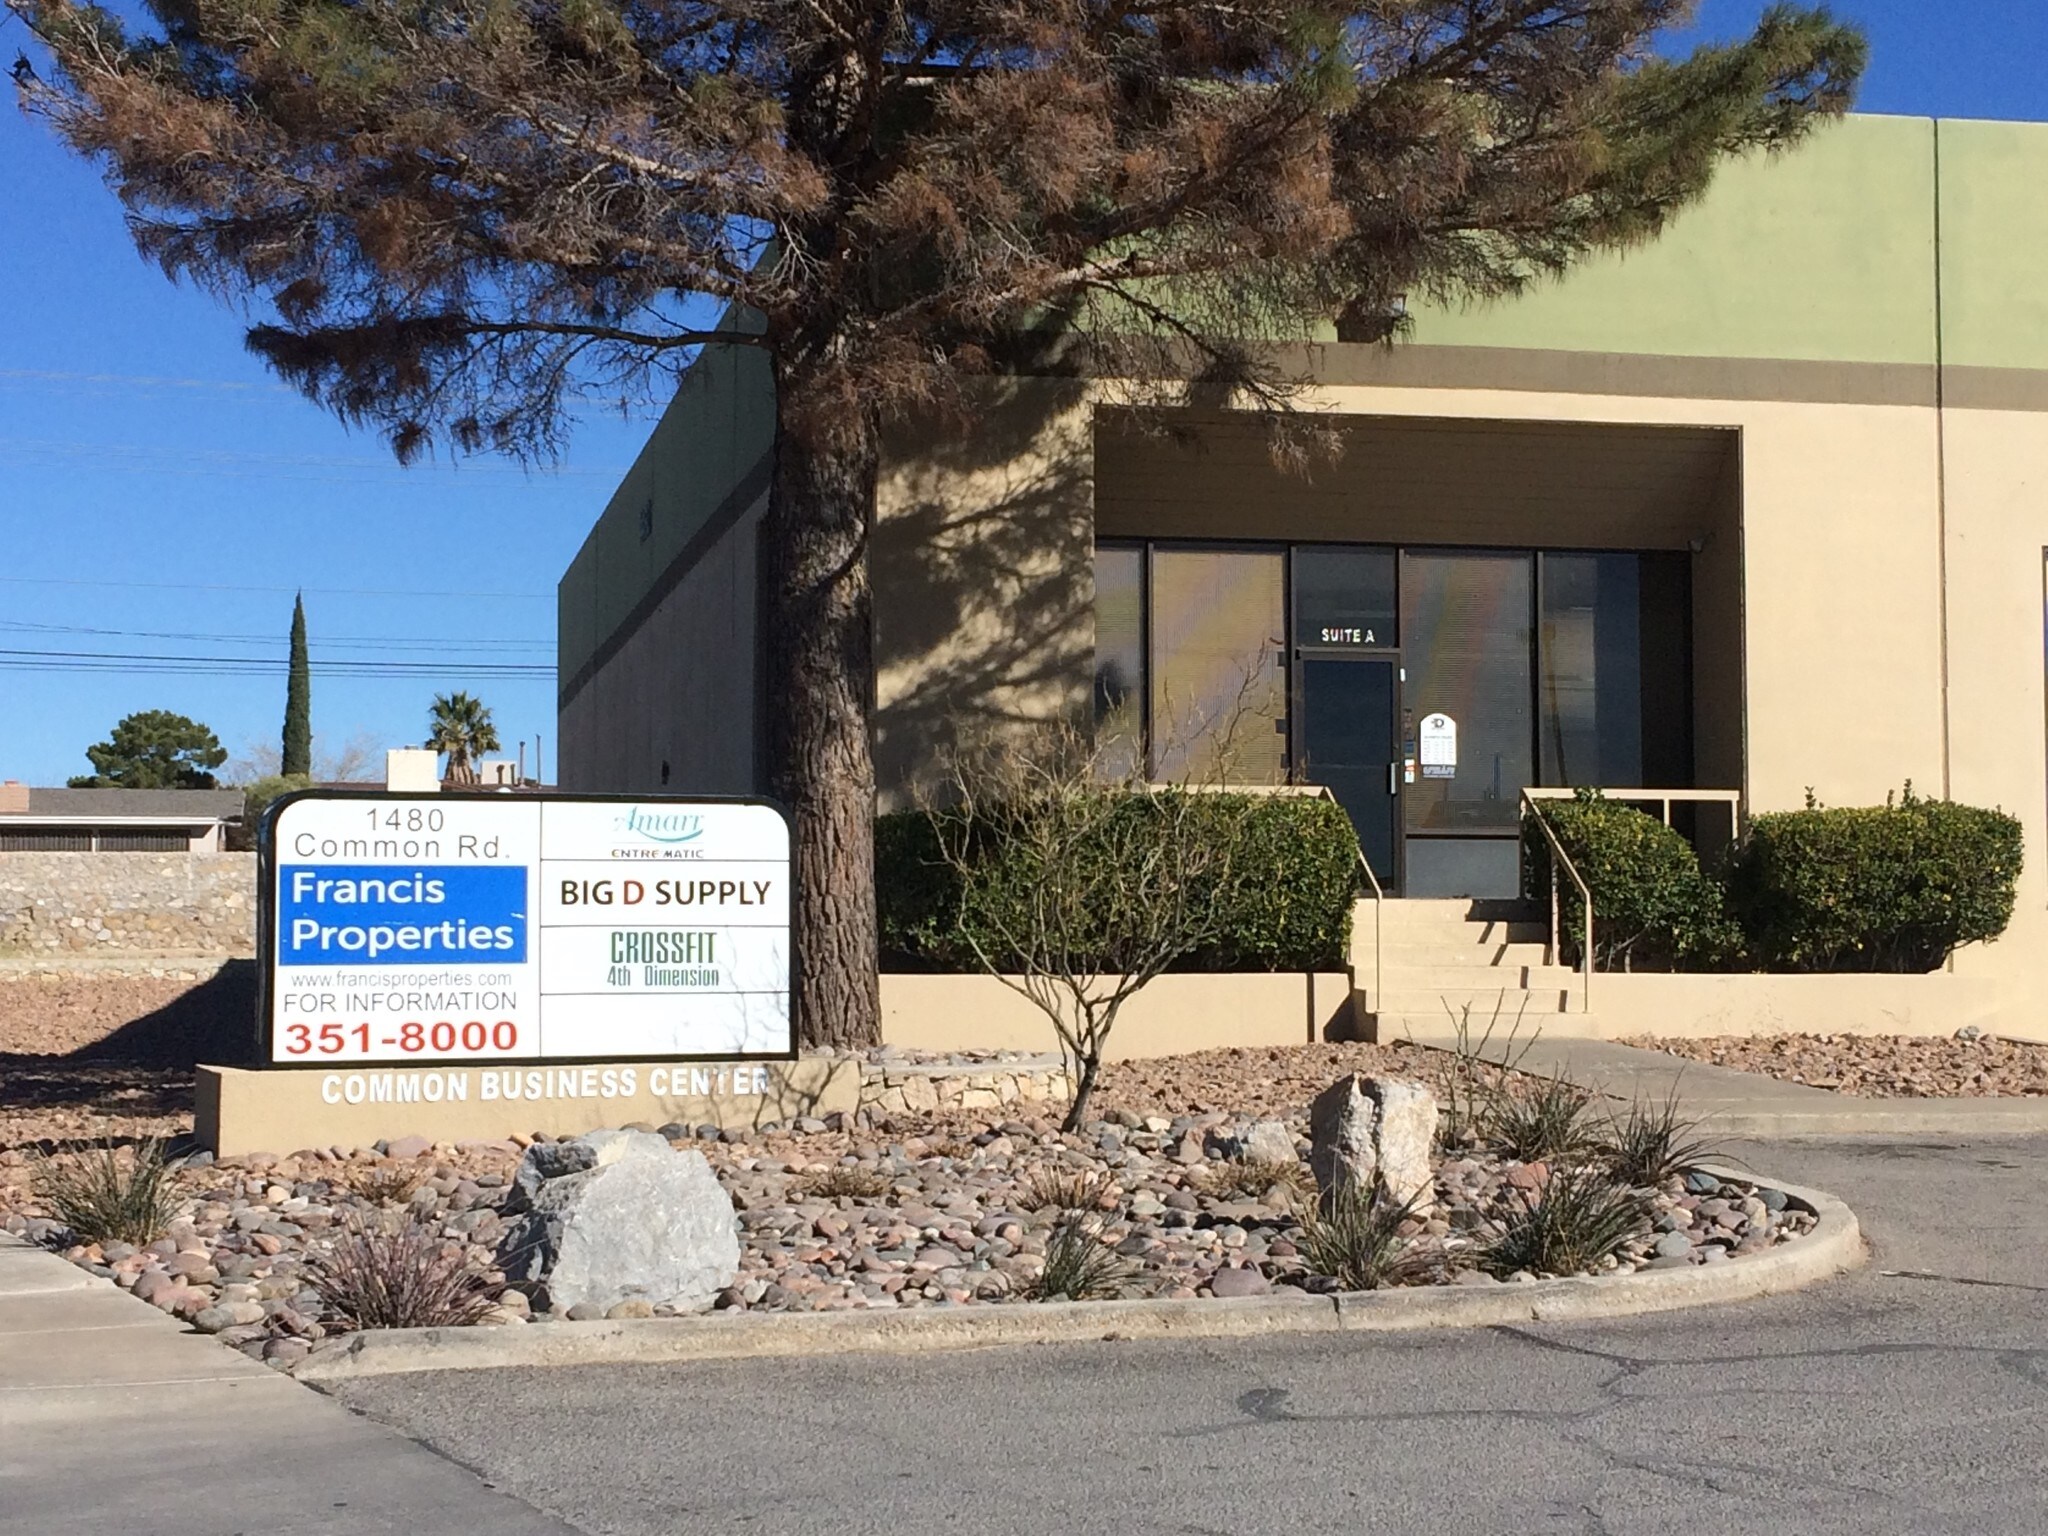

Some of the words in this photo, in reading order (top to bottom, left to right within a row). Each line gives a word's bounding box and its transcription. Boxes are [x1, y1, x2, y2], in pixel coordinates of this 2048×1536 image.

[1321, 628, 1361, 643] SUITE
[1364, 629, 1375, 643] A
[367, 808, 444, 832] 1480
[295, 833, 440, 858] Common
[458, 835, 511, 859] Rd.
[293, 872, 446, 904] Francis
[561, 880, 614, 905] BIG
[623, 880, 645, 905] D
[655, 880, 772, 905] SUPPLY
[292, 919, 514, 958] Properties
[611, 931, 718, 964] CROSSFIT
[291, 970, 512, 989] www.francisproperties.com
[607, 966, 631, 987] 4th
[644, 965, 720, 987] Dimension
[284, 993, 337, 1013] FOR
[346, 992, 517, 1012] INFORMATION
[286, 1021, 518, 1054] 351-8000
[321, 1072, 468, 1105] COMMON
[481, 1067, 637, 1101] BUSINESS
[649, 1067, 769, 1097] CENTER
